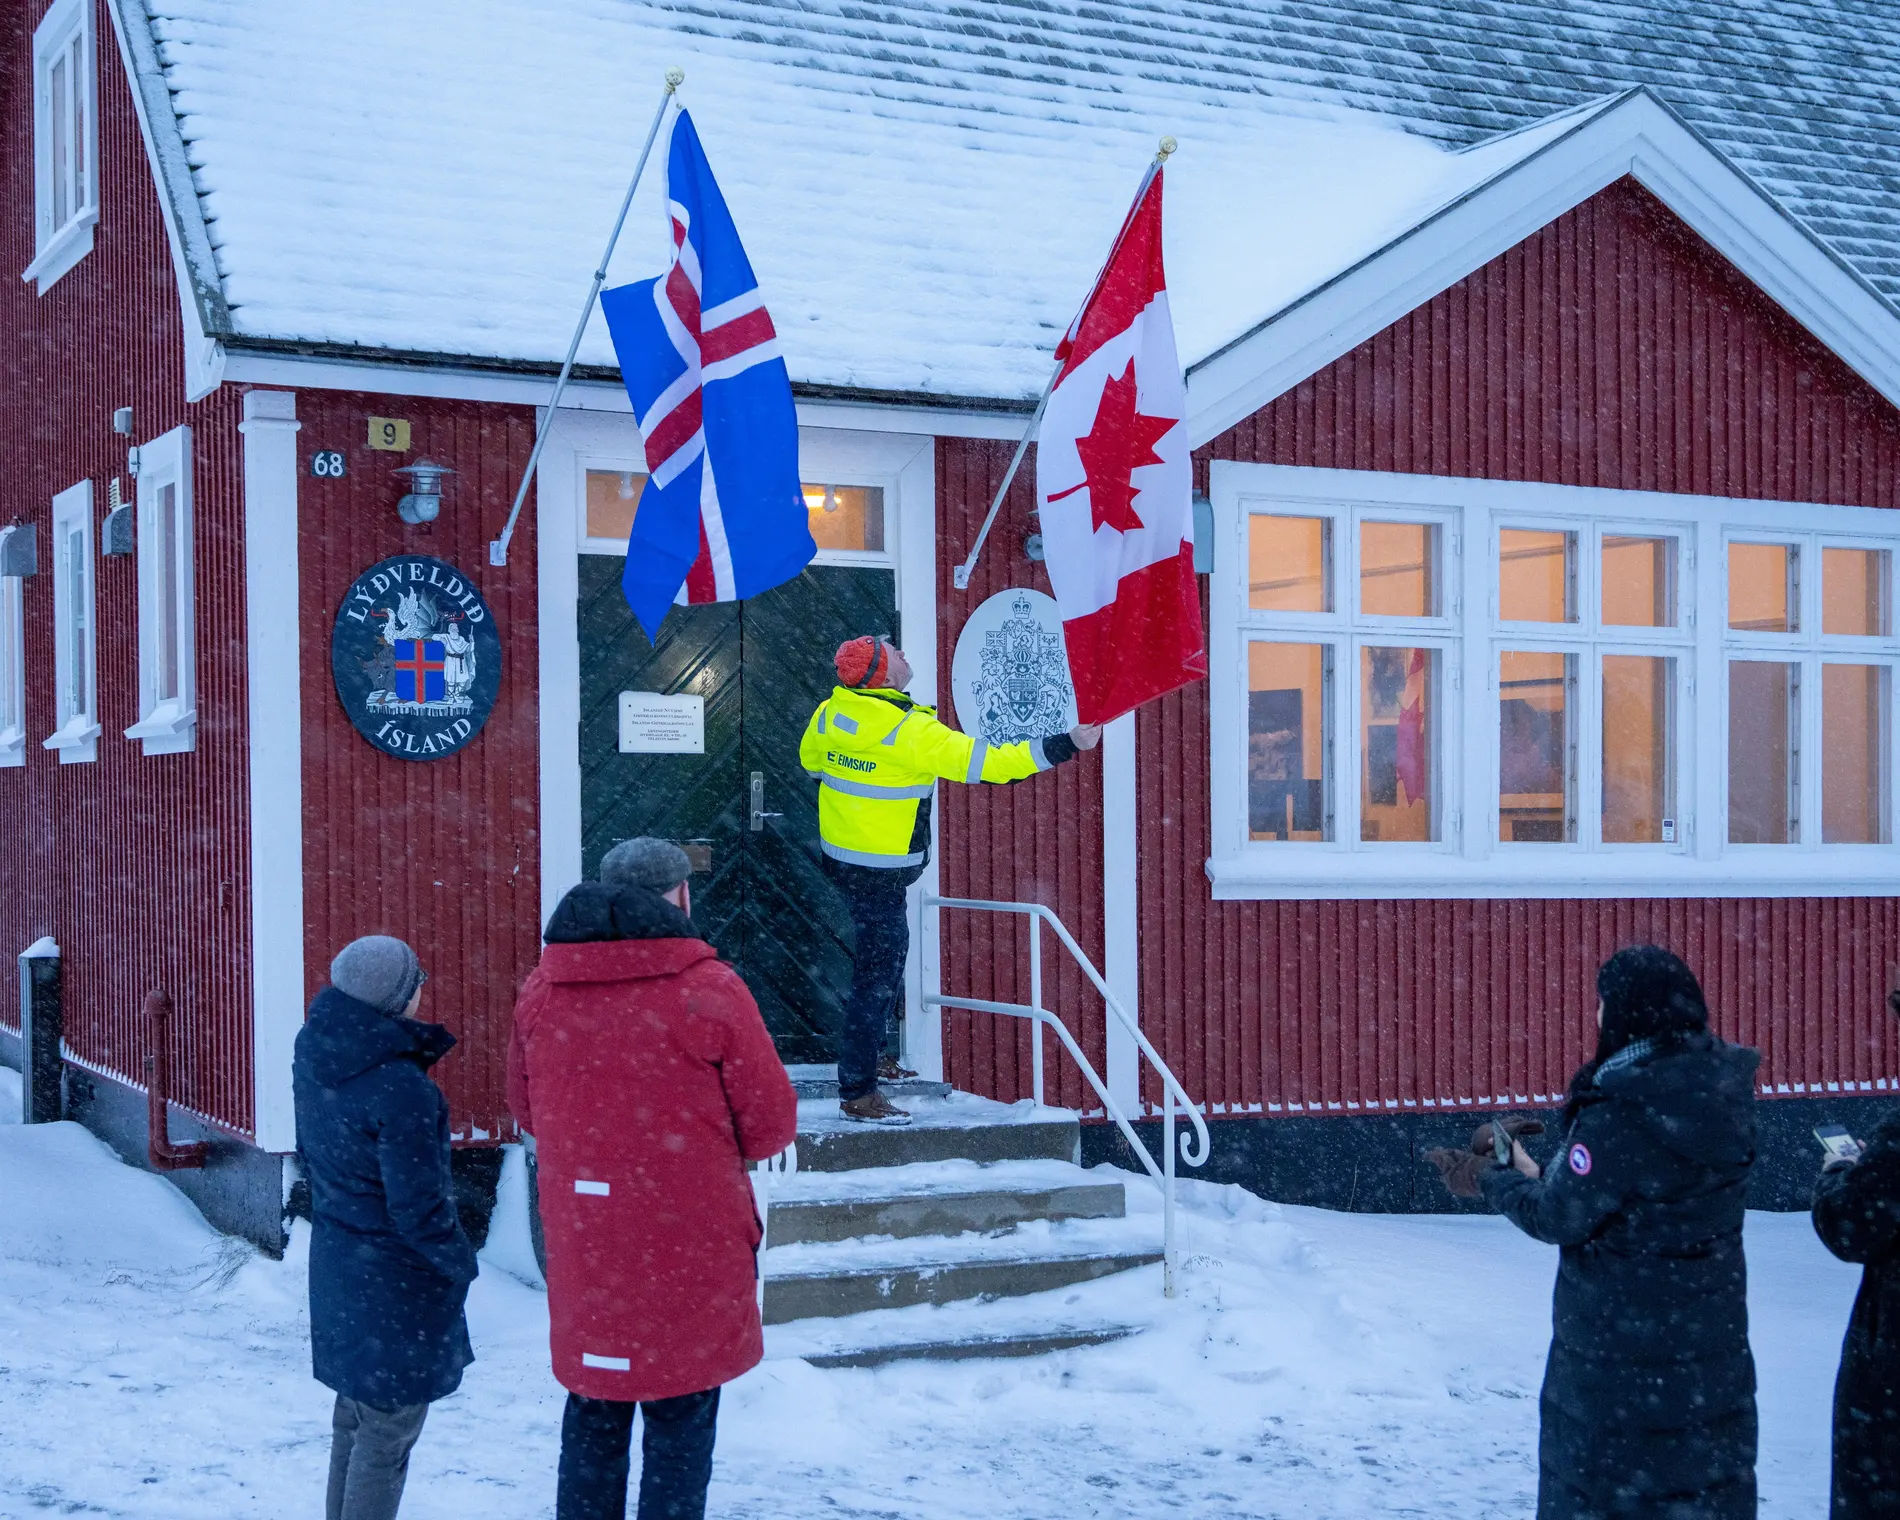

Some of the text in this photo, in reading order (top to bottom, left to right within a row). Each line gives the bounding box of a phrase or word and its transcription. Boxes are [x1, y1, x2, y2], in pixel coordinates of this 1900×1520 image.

[383, 423, 396, 445] 9
[314, 452, 343, 477] 68
[347, 563, 485, 623] LÝÐVELDIÐ
[375, 718, 471, 753] ÍSLAND
[838, 754, 877, 773] EIMSKIP
